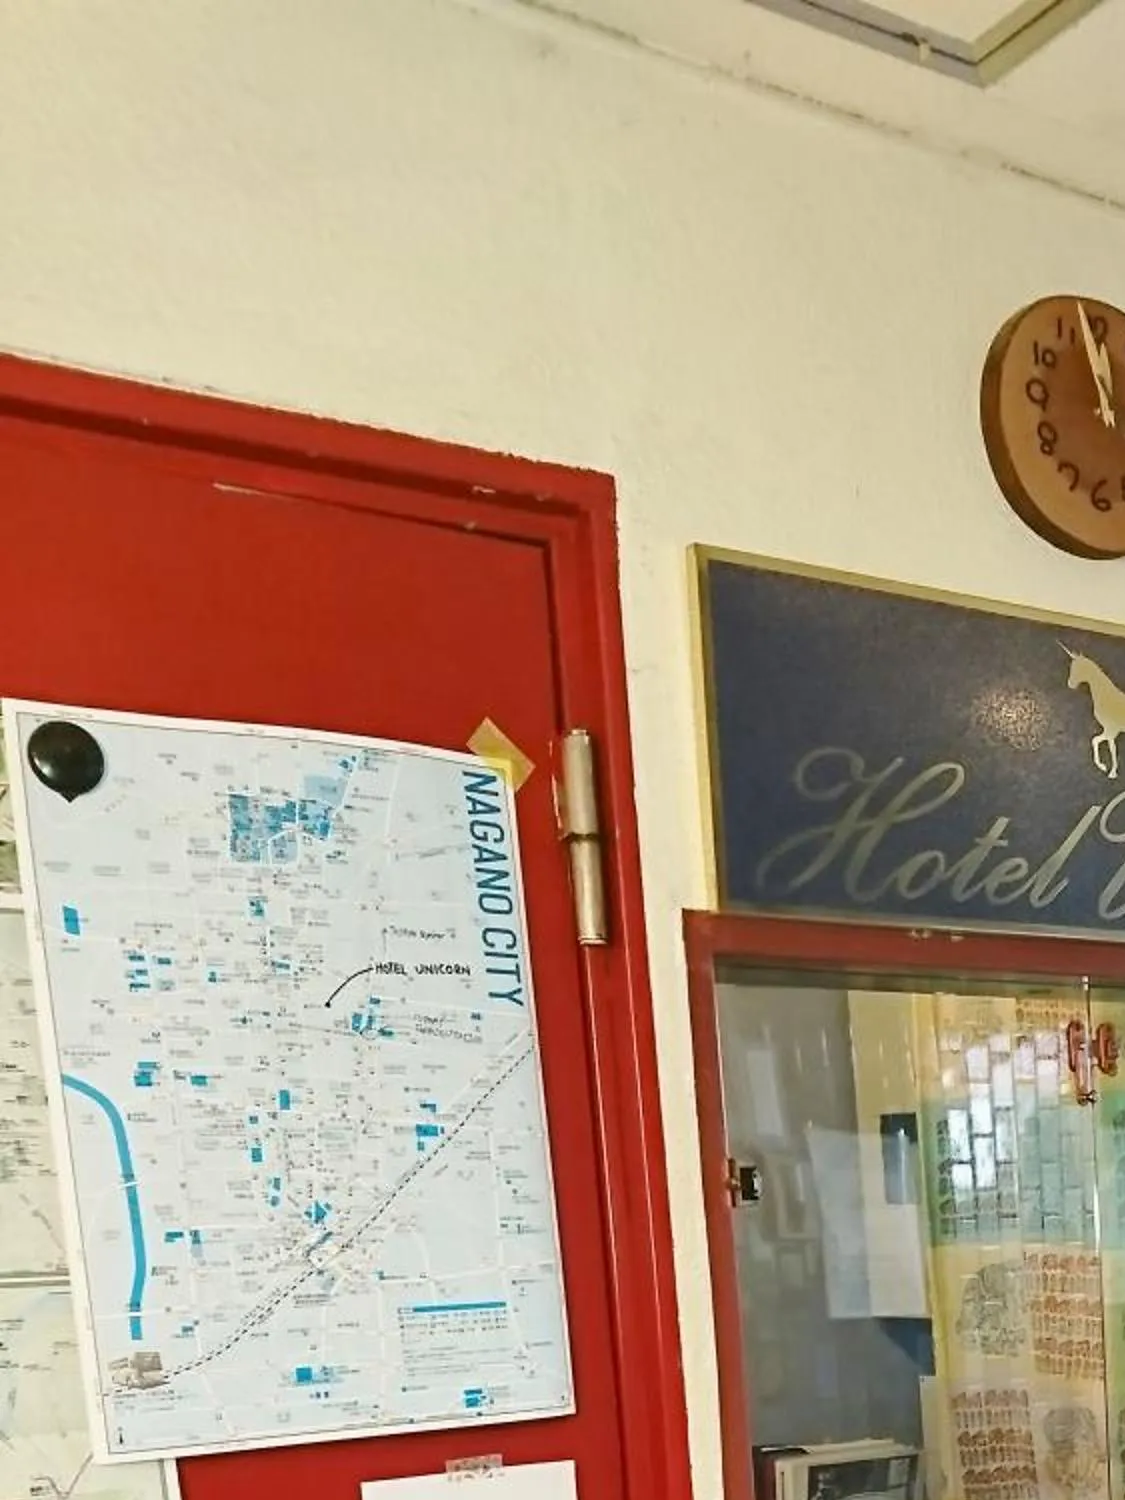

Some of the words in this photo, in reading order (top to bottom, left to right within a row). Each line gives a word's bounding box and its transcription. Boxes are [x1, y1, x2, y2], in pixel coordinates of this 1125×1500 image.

[1033, 341, 1057, 368] 10
[1025, 378, 1050, 411] 9
[1037, 422, 1057, 457] 8
[1057, 462, 1080, 492] 7
[1091, 480, 1113, 512] 6
[462, 768, 514, 917] NAGANO
[755, 745, 1101, 911] Hotel
[375, 961, 408, 977] HOTEL
[415, 962, 471, 976] UNICORN
[481, 926, 524, 1007] CITY
